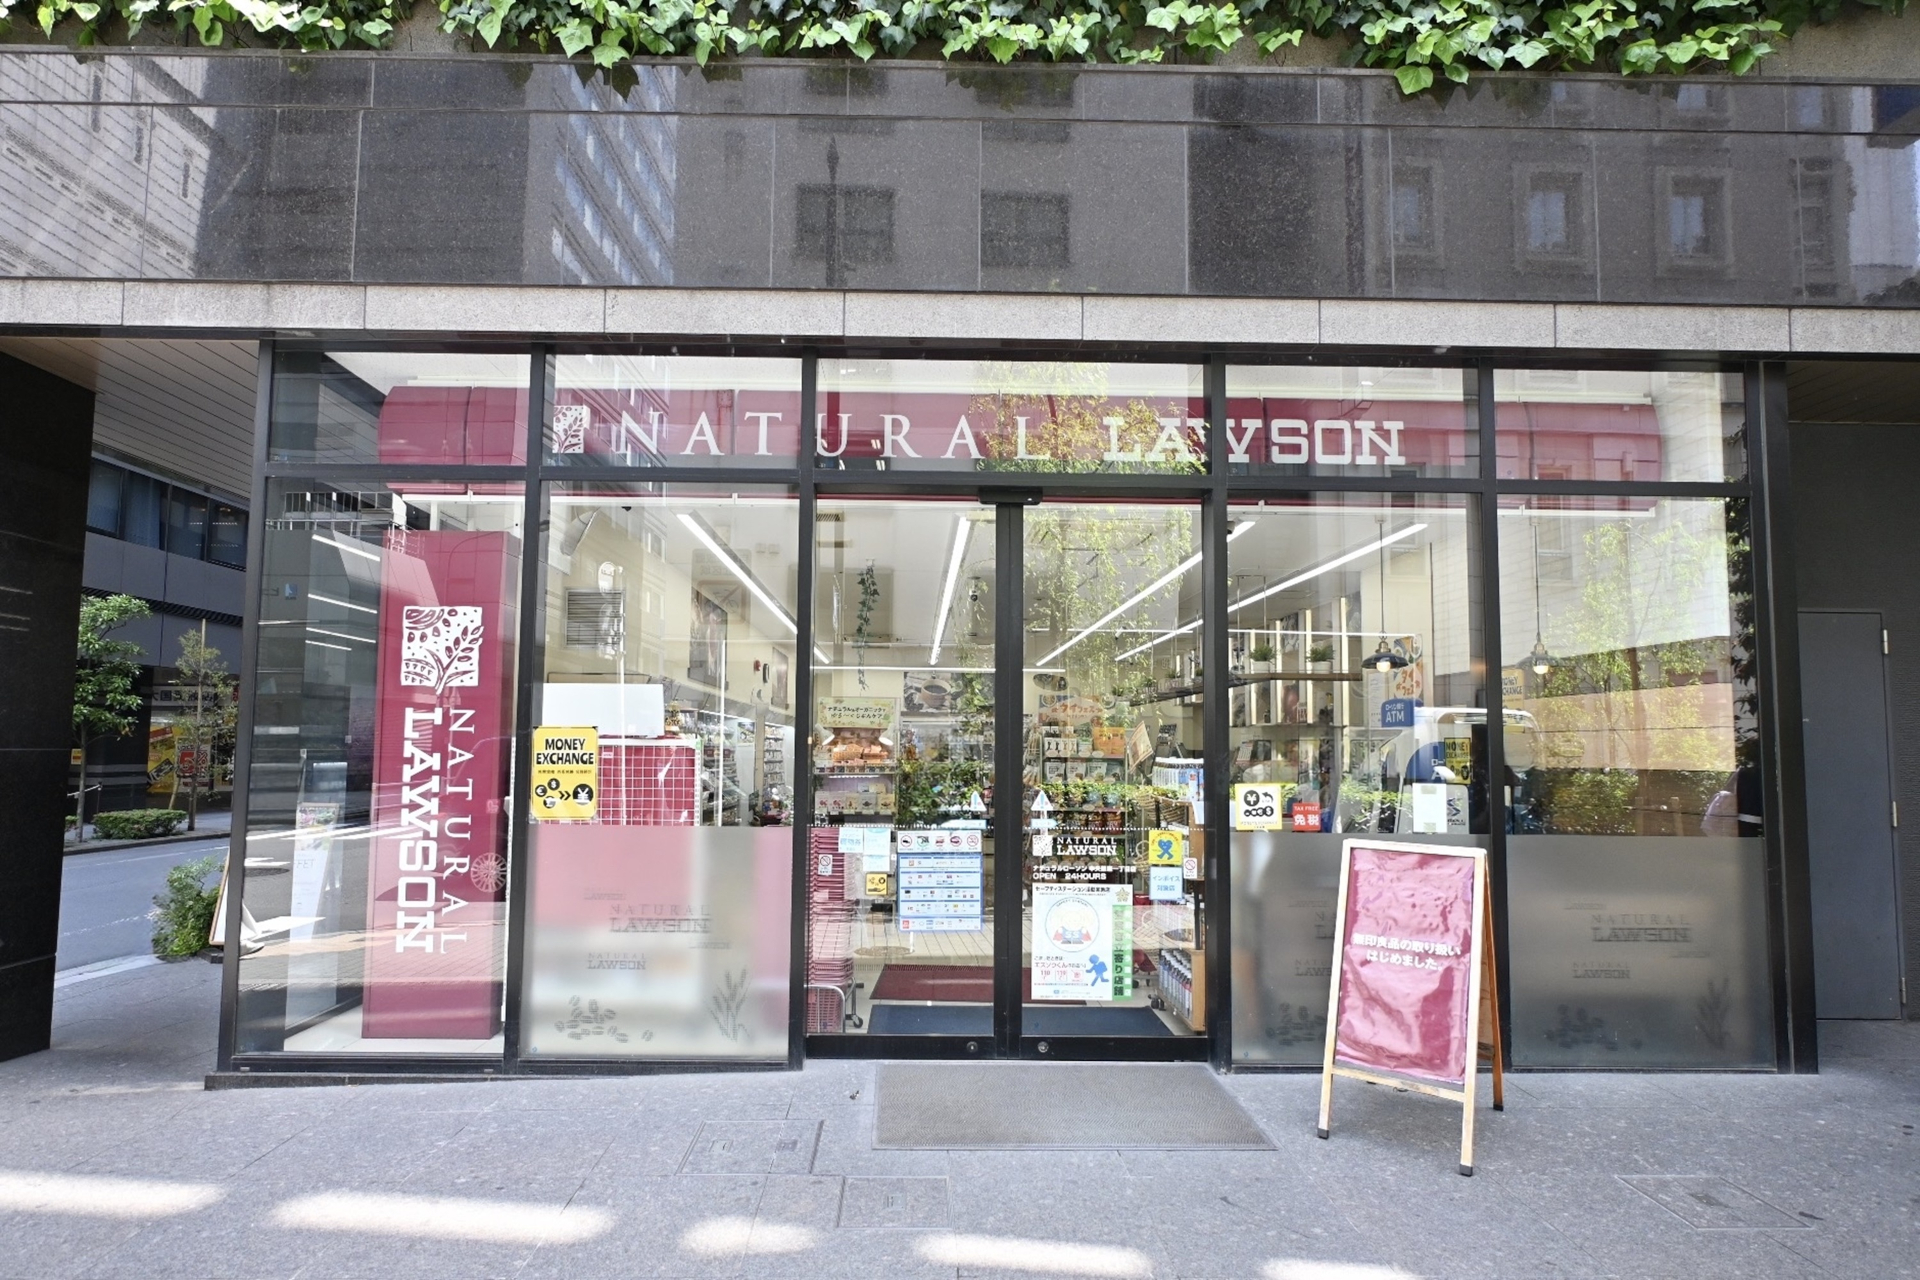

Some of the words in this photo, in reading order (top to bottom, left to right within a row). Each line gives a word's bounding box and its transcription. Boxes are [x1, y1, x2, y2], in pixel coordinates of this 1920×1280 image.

[611, 409, 1051, 461] NATURAL
[1102, 416, 1406, 466] LAWSON
[1385, 711, 1405, 723] ATM
[545, 738, 586, 751] MONEY
[536, 752, 594, 765] EXCHANGE
[1293, 814, 1320, 826] 免税
[395, 707, 443, 953] LAWSON
[441, 708, 476, 954] NATURAL
[1056, 836, 1117, 844] NATURAL
[1056, 845, 1117, 856] LAWSON
[609, 903, 712, 916] NATURAL
[608, 917, 713, 933] LAWSON
[1591, 914, 1691, 926] NATURAL
[1591, 927, 1692, 942] LAWSON
[1352, 932, 1461, 956] 無印良品の取り扱い
[587, 960, 647, 970] LAWSON
[1366, 949, 1443, 971] はじめました。
[1572, 969, 1631, 979] LAWSON
